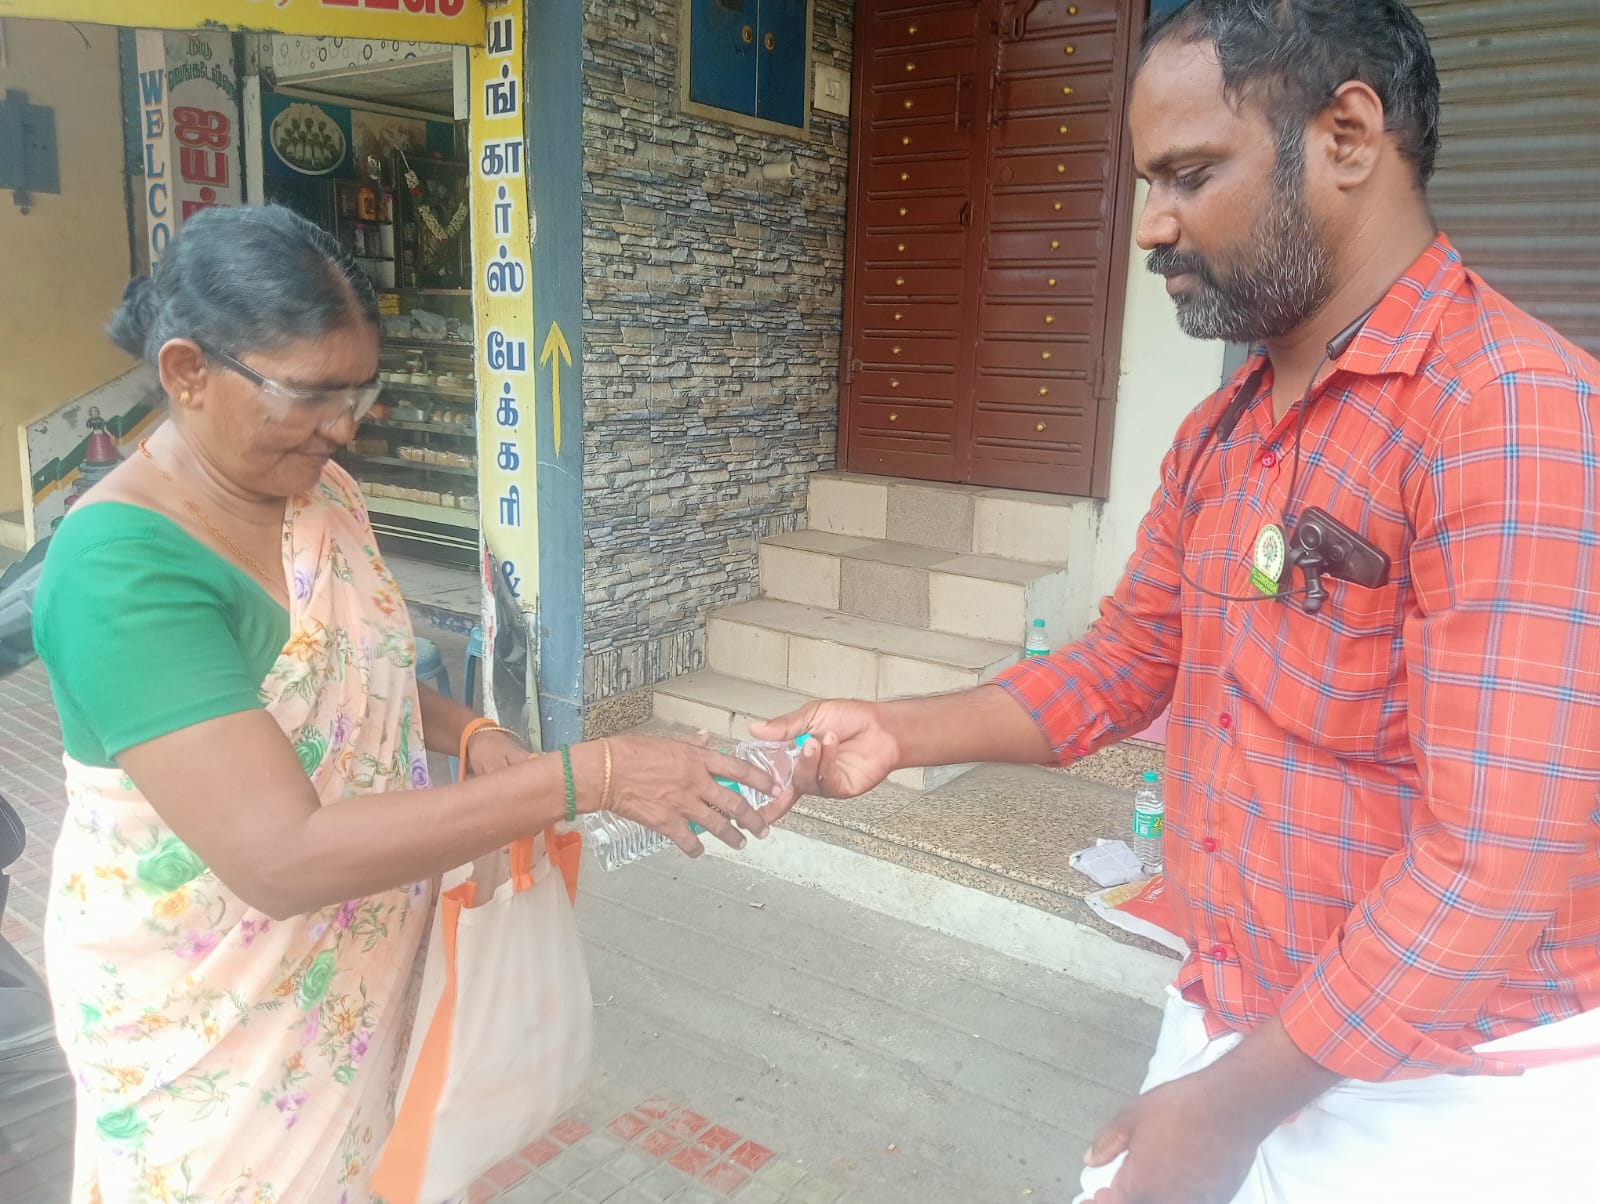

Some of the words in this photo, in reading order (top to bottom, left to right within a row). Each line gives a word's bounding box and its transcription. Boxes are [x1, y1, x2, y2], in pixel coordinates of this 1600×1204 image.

[139, 68, 171, 275] WELCO
[481, 0, 524, 293] யங்கார்ஸ்
[486, 330, 526, 528] பேக்கரி
[501, 560, 521, 598] &
